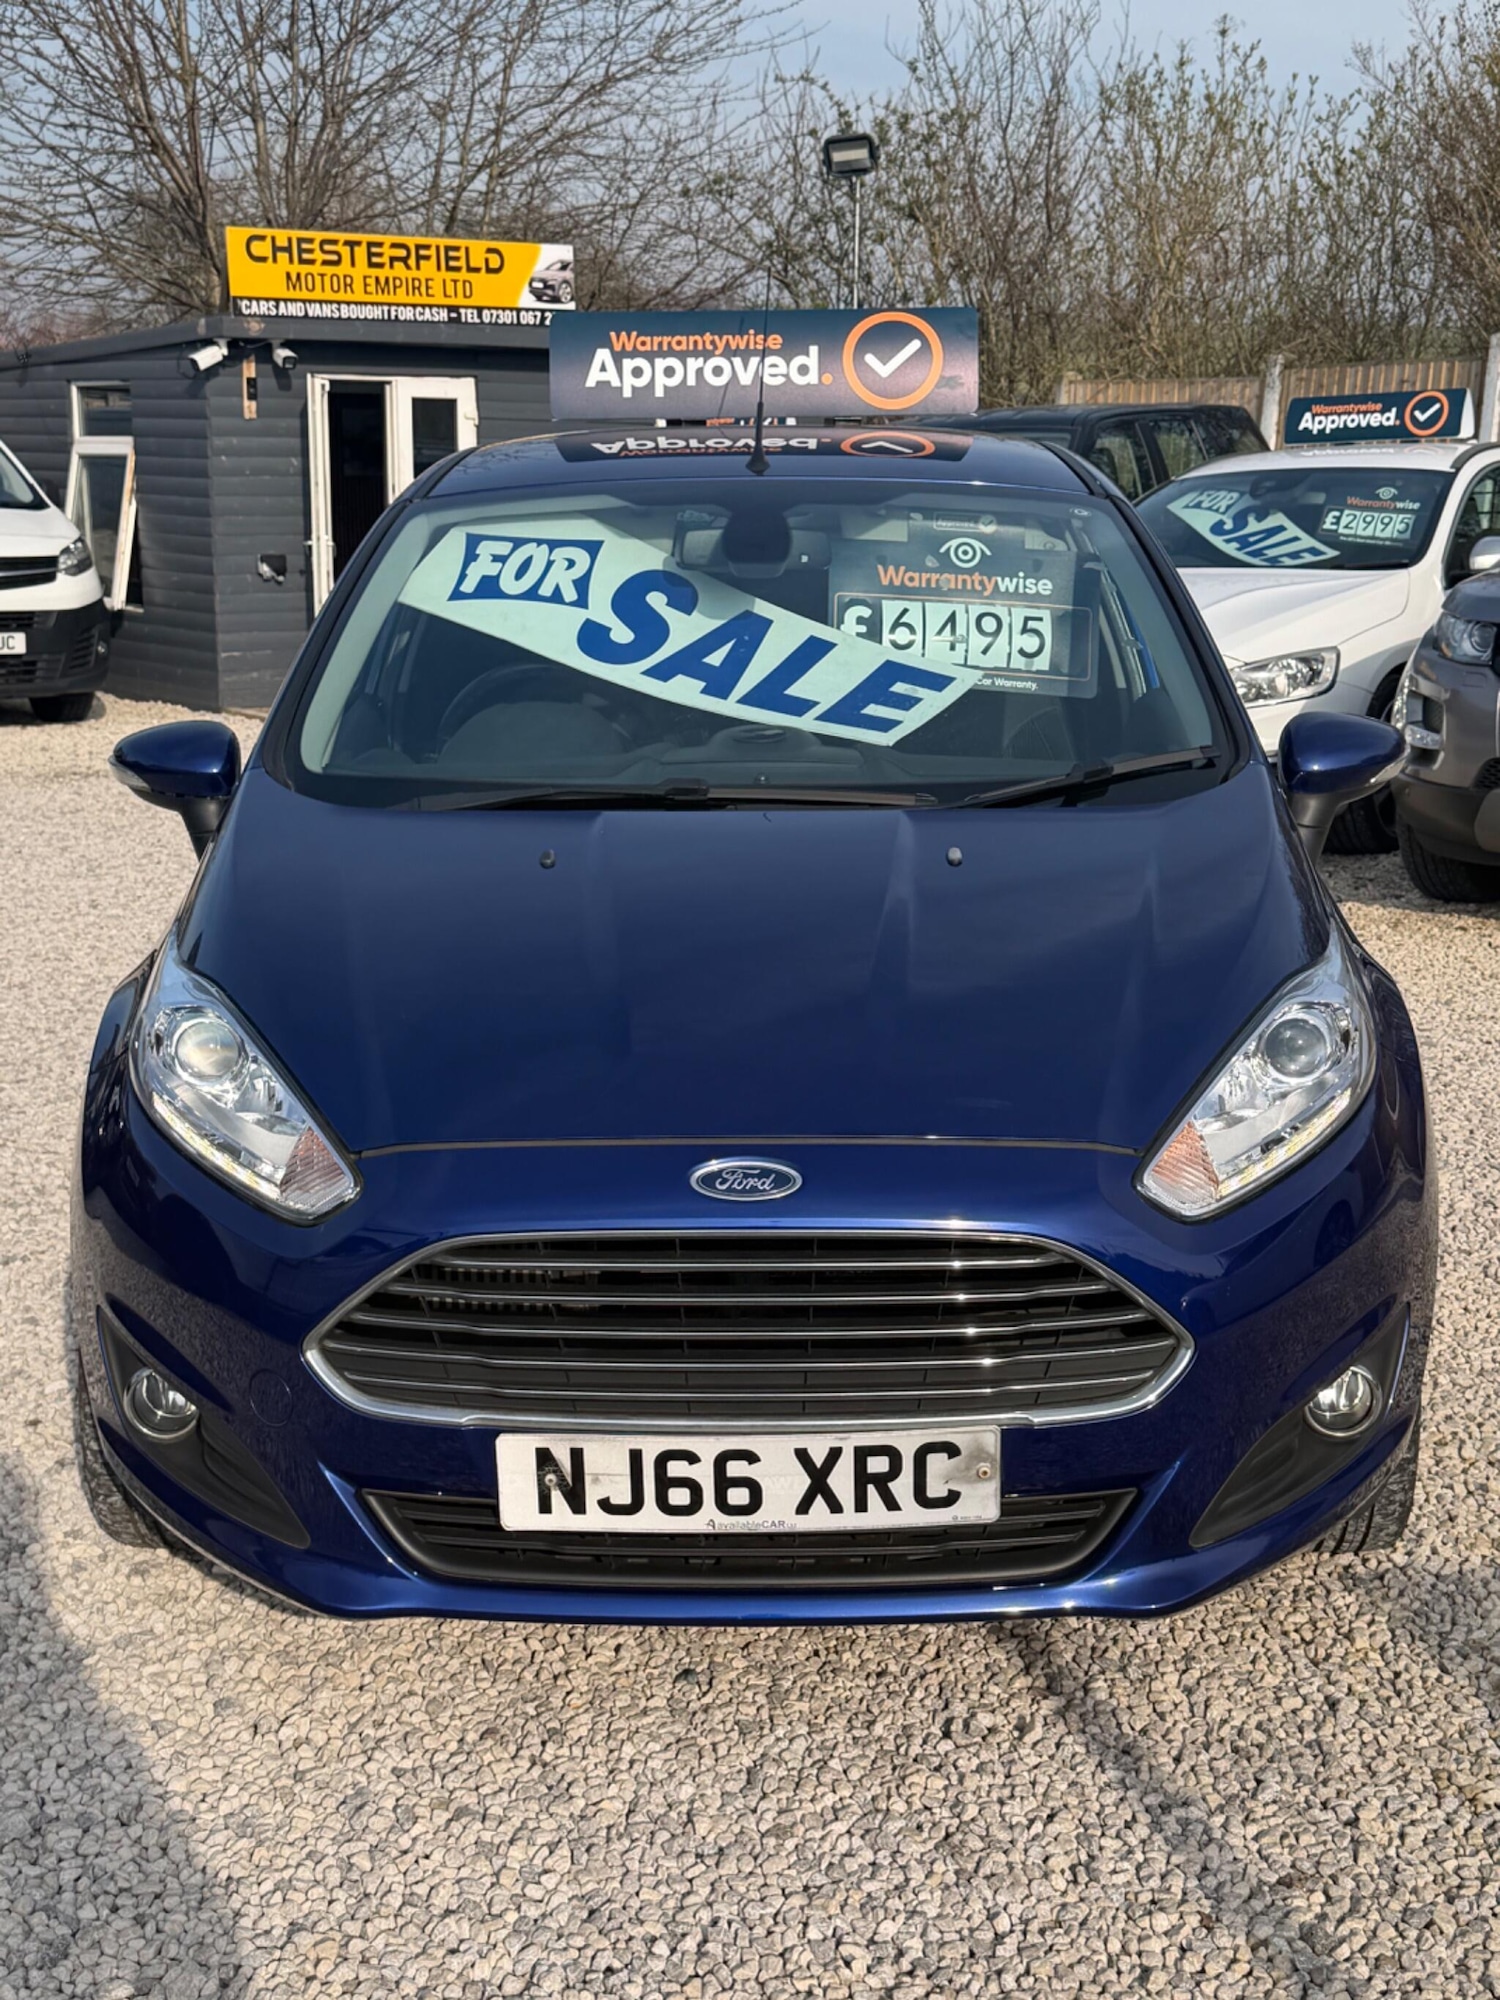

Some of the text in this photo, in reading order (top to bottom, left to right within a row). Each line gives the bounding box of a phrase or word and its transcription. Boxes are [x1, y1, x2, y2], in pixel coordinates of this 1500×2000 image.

[245, 234, 505, 274] CHESTERFIELD
[285, 271, 474, 299] MOTOR EMPIRE LTD
[241, 299, 277, 316] CARS
[278, 301, 305, 317] AND
[305, 302, 340, 318] VANS
[340, 304, 390, 320] BOUGHT
[391, 306, 415, 321] FOR
[415, 307, 448, 322] CASH
[459, 309, 480, 323] TEL
[482, 310, 517, 325] 07301
[520, 312, 541, 325] 067
[609, 329, 783, 355] Warrantywise
[584, 345, 834, 398] Approved.
[1298, 407, 1401, 434] Approved.
[1311, 402, 1383, 414] Warrantywise
[1189, 490, 1240, 513] FOR
[1347, 495, 1421, 511] Warrantywise
[1209, 505, 1329, 566] SALE
[1322, 511, 1412, 535] £2995
[460, 540, 591, 603] FOR
[877, 564, 1053, 596] Warrantywise
[577, 569, 957, 734] SALE
[715, 1168, 775, 1190] Ford
[535, 1441, 963, 1516] NJ66 XRC
